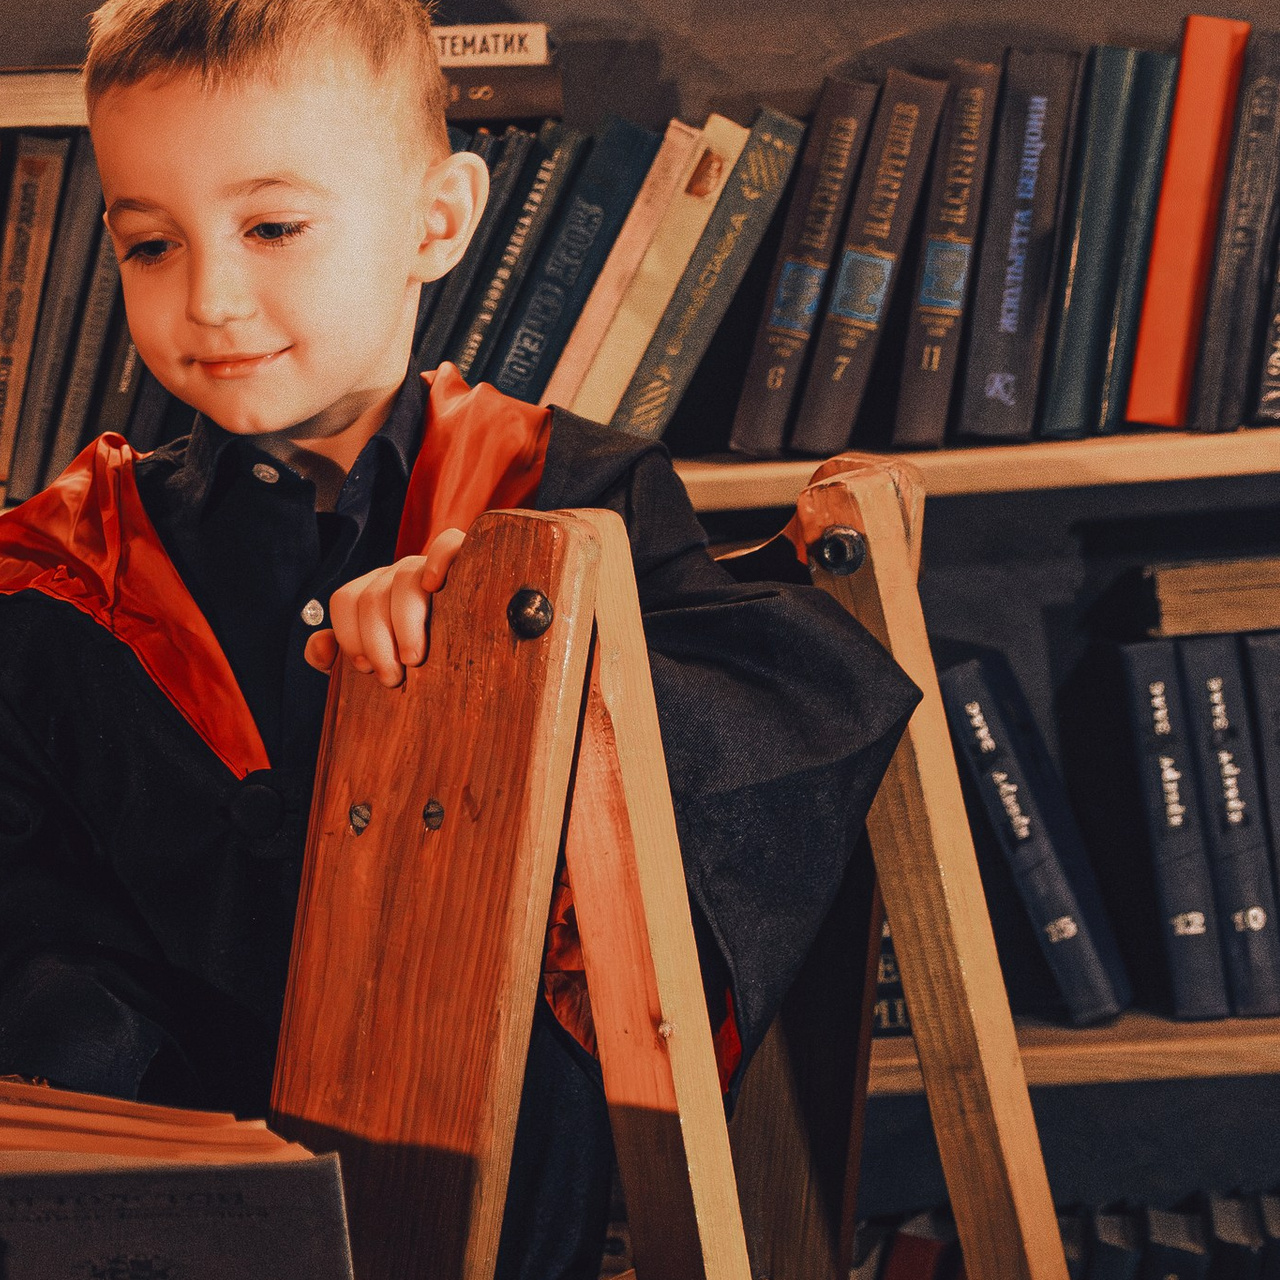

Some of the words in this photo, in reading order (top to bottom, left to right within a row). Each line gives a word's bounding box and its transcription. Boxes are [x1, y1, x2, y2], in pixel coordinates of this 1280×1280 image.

[436, 31, 531, 57] ТЕМАТИК
[1000, 208, 1032, 333] ЖЮЛЬЕТТА
[831, 355, 851, 382] 7
